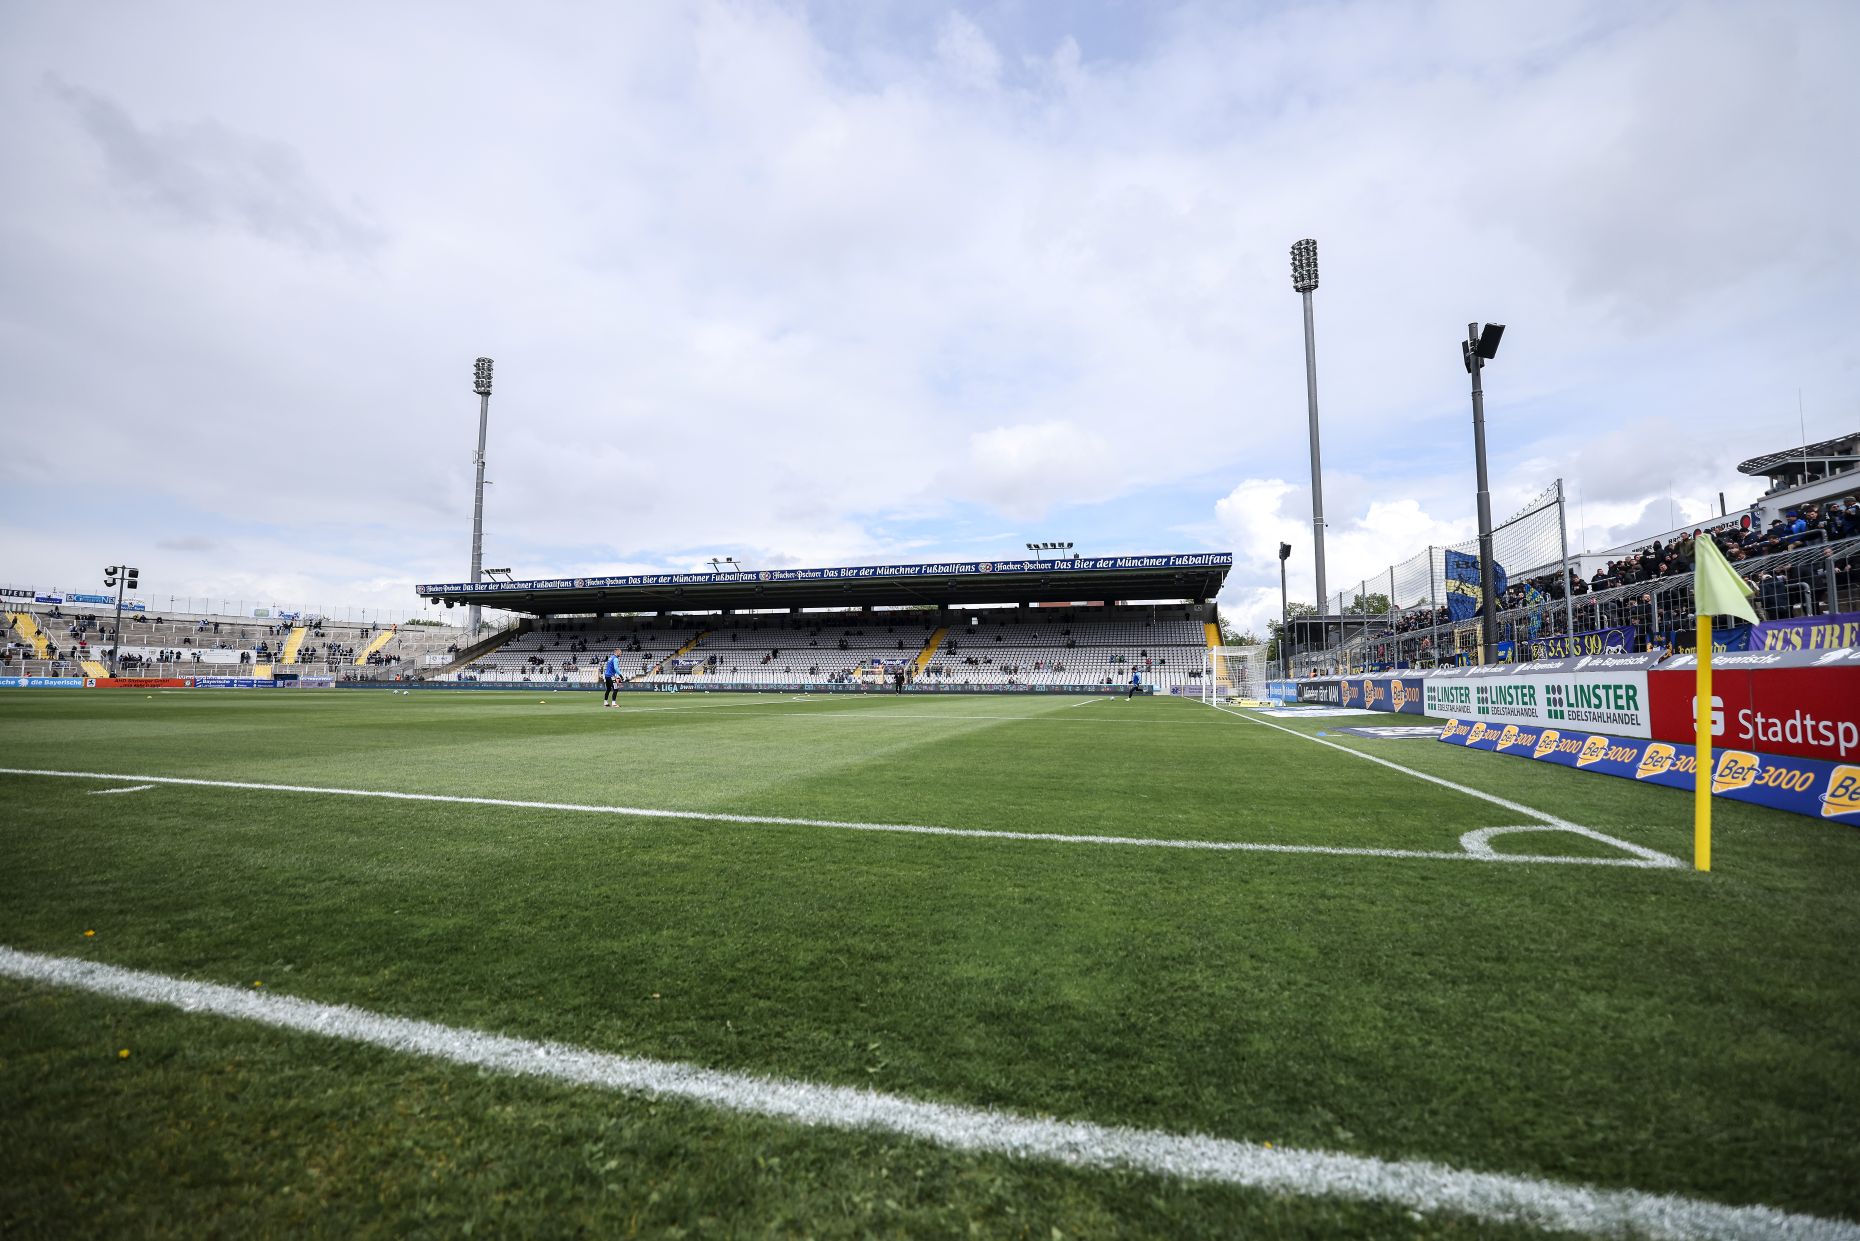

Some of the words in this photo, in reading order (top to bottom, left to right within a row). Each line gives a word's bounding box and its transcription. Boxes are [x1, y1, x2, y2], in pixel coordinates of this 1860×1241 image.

[823, 569, 838, 578] Das
[841, 568, 856, 577] Bier
[860, 567, 874, 576] der
[876, 565, 920, 575] Münchner
[922, 563, 975, 573] Fußballfans
[995, 562, 1052, 574] Hacker-Pschorr
[1054, 560, 1072, 570] Das
[1074, 559, 1090, 569] Bier
[1096, 558, 1112, 568] der
[1116, 556, 1166, 567] Münchner
[1169, 554, 1233, 566] Fußballfans
[488, 583, 499, 591] der
[500, 582, 532, 590] Münchner
[533, 580, 572, 589] Fußballfans
[642, 575, 656, 584] Bier
[659, 575, 671, 583] der
[672, 574, 708, 583] Münchner
[711, 572, 756, 582] Fußballfans
[1765, 627, 1803, 652] FCS
[1588, 657, 1601, 666] die
[1601, 656, 1648, 668] Bayerische
[661, 684, 678, 692] LIGA
[1328, 686, 1339, 702] MAN
[1437, 686, 1471, 704] LINSTER
[1489, 685, 1537, 707] LINSTER
[1565, 684, 1640, 712] LINSTER
[1437, 704, 1472, 714] EDELSTAHLHANDEL
[1491, 706, 1539, 718] EDELSTAHLHANDEL
[1568, 710, 1641, 726] EDELSTAHLHANDEL
[1738, 709, 1859, 757] Stadtsp
